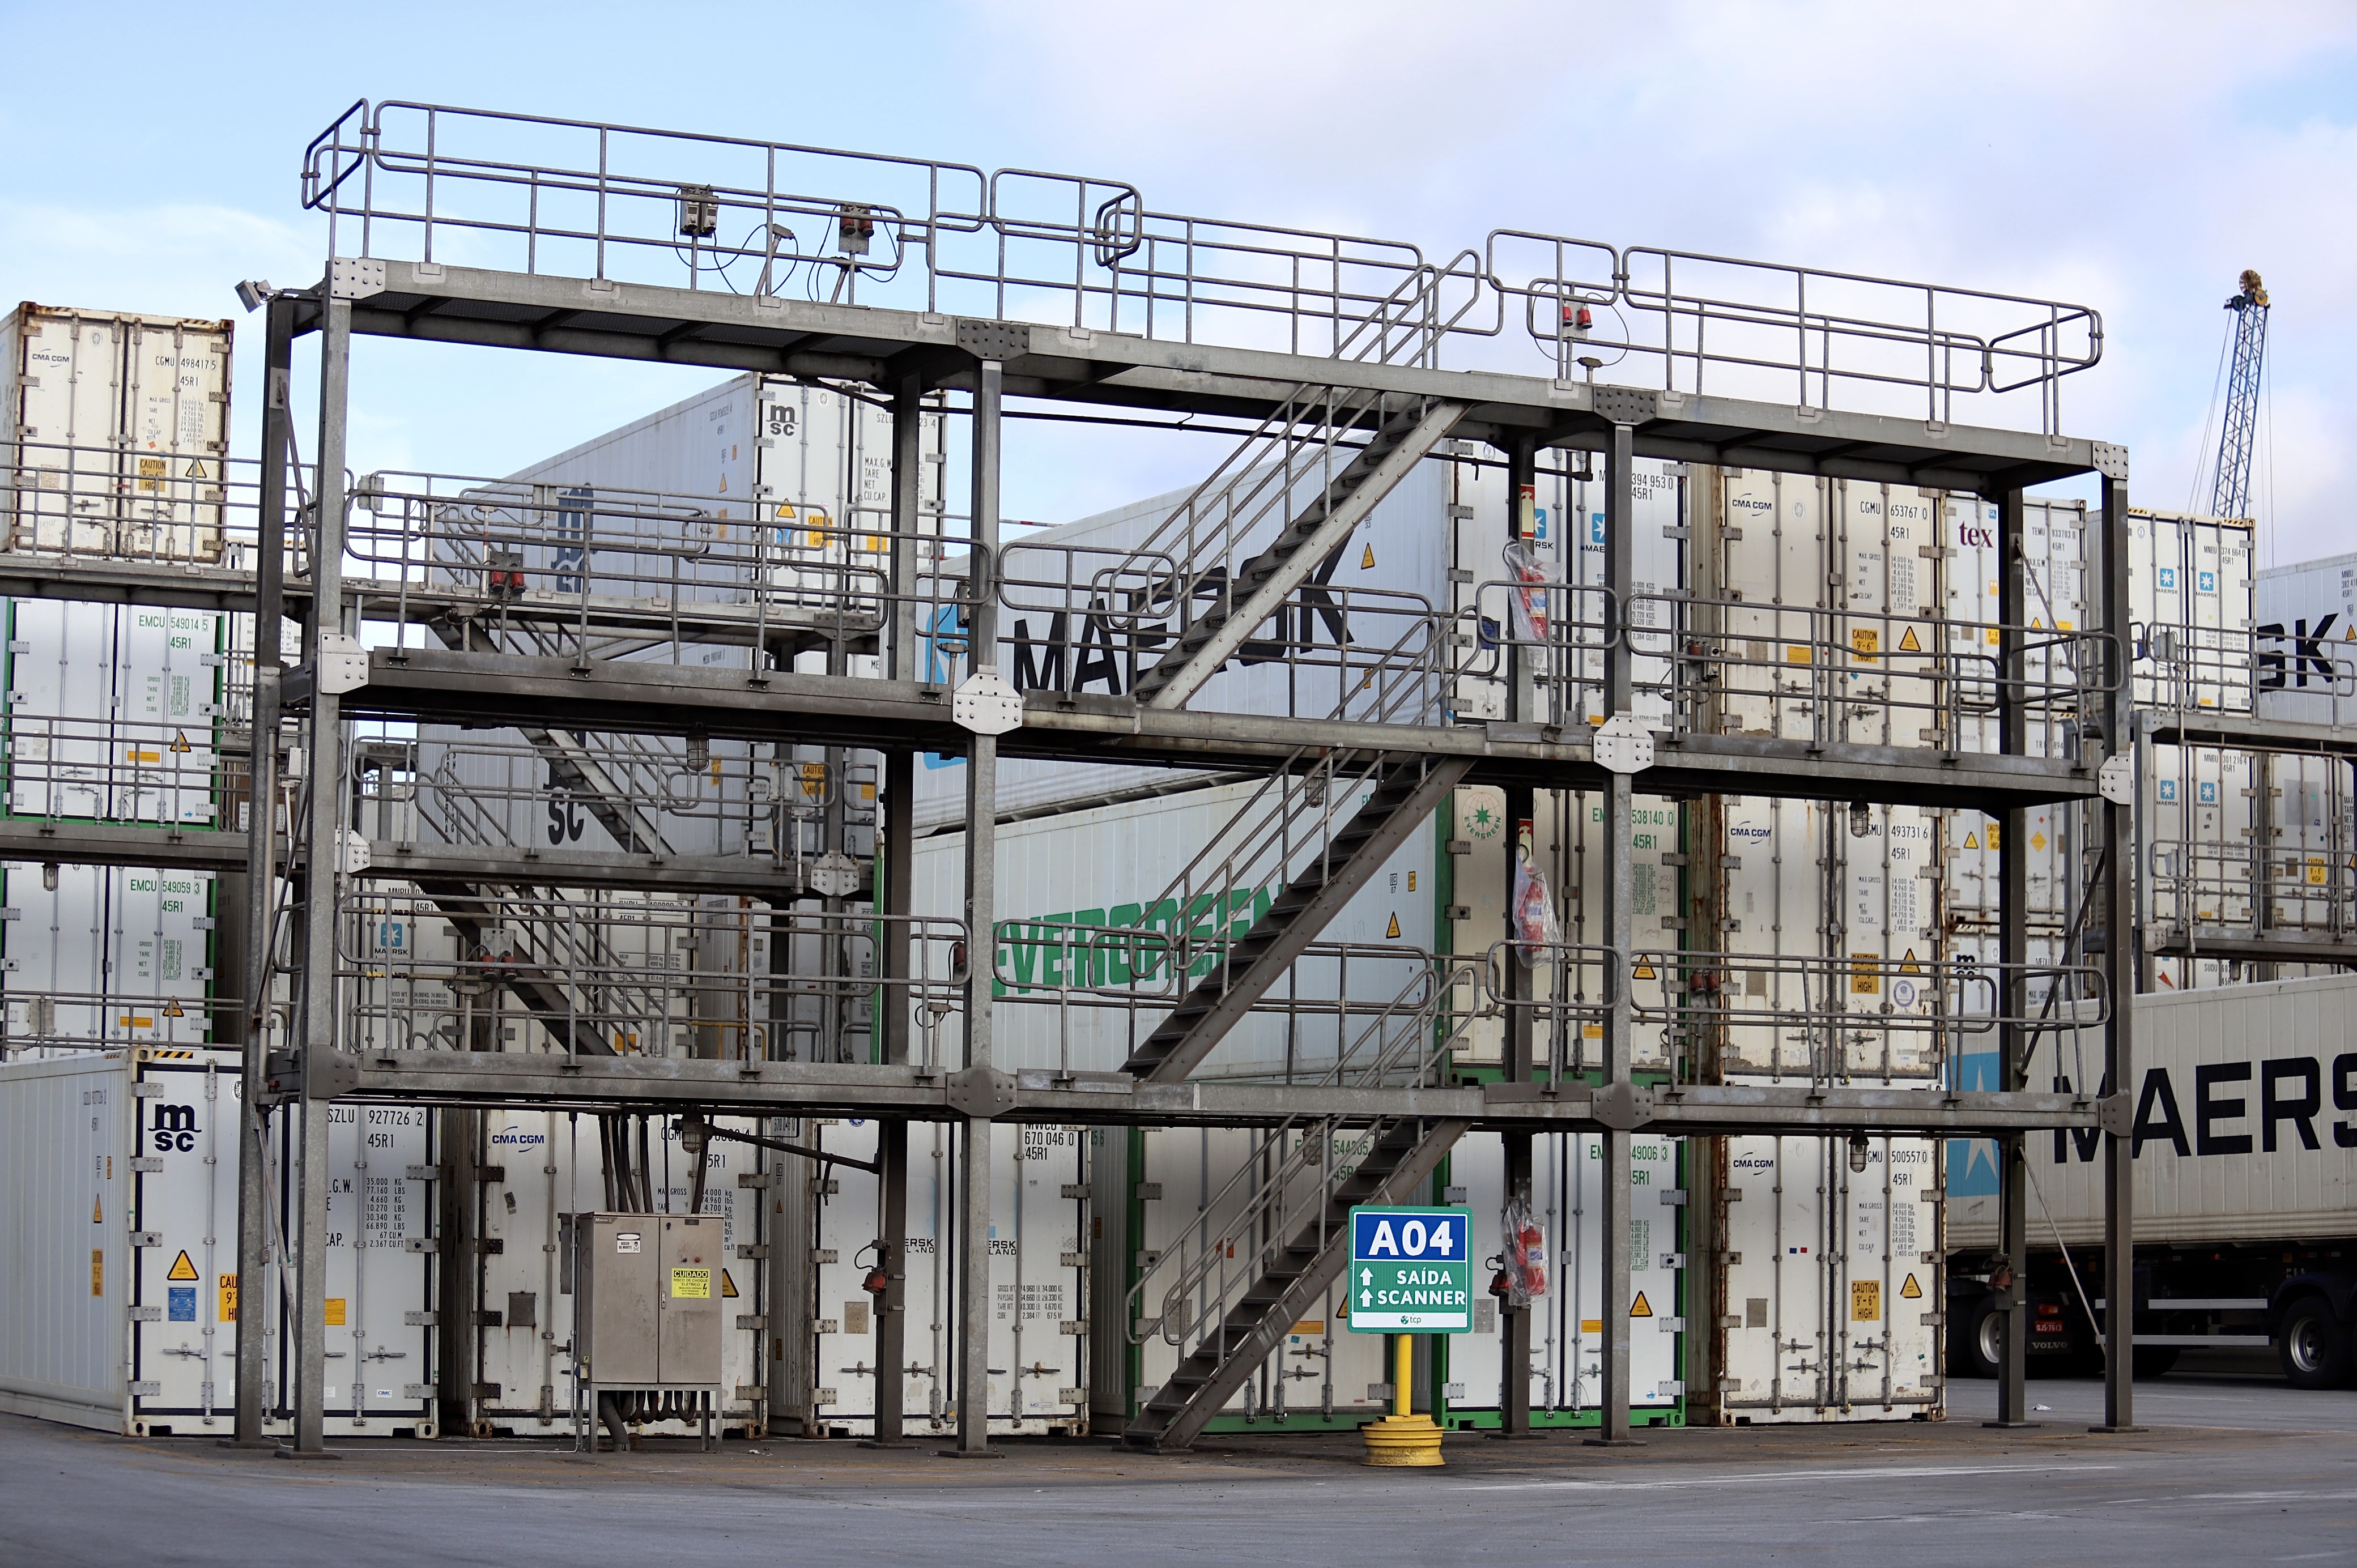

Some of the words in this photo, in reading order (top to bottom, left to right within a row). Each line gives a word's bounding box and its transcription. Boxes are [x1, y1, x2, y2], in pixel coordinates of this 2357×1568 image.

[32, 353, 50, 361] CMA
[155, 356, 175, 367] CGMU
[181, 357, 209, 370] 498417
[180, 376, 199, 387] 45R1
[140, 459, 165, 470] CAUTION
[865, 468, 879, 479] TARE
[864, 480, 875, 489] NET
[1632, 473, 1648, 486] 394
[1649, 475, 1666, 488] 953
[863, 491, 887, 502] CU.CAP.
[1632, 487, 1653, 501] 45R1
[1732, 499, 1751, 509] CMA
[1752, 501, 1772, 510] CGM
[1860, 501, 1881, 514] CGMU
[1890, 504, 1918, 519] 653767
[1890, 526, 1910, 540] 45R1
[1959, 520, 1993, 548] tex
[2031, 527, 2045, 536] TEMU
[2052, 542, 2065, 551] 45R1
[2203, 546, 2217, 555] MNBU
[2221, 547, 2231, 556] 374
[2232, 549, 2241, 557] 664
[2342, 570, 2354, 578] MNBU
[2342, 589, 2352, 598] 45R1
[139, 615, 165, 628] EMCU
[171, 616, 199, 630] 549014
[203, 620, 208, 631] 5
[1853, 629, 1877, 641] CAUTION
[170, 637, 192, 649] 45R1
[2203, 754, 2219, 763] MNBU
[2233, 756, 2243, 765] 216
[2223, 765, 2235, 773] 45R1
[1632, 809, 1663, 825] 538140
[1463, 816, 1501, 840] EVERGREEN
[1731, 828, 1750, 837] CMA
[1751, 829, 1771, 838] CGM
[1633, 833, 1657, 850] 45R1
[1891, 847, 1911, 860] 45R1
[130, 879, 157, 892] EMCU
[162, 880, 191, 894] 549059
[195, 883, 199, 894] 3
[162, 901, 183, 913] 45R1
[1857, 981, 1873, 993] HIGH
[329, 1109, 355, 1123] SZLU
[368, 1110, 410, 1126] 927726
[416, 1111, 424, 1127] 2
[367, 1133, 394, 1148] 45R1
[492, 1135, 518, 1144] CMA
[519, 1134, 544, 1144] CGM
[1024, 1132, 1043, 1145] 670
[1046, 1133, 1064, 1146] 046
[1067, 1133, 1075, 1147] 0
[1026, 1147, 1048, 1160] 45R1
[1867, 1151, 1883, 1163] GMU
[1891, 1151, 1921, 1163] 500557
[1922, 1151, 1928, 1163] 0
[708, 1154, 726, 1168] 5R1
[1630, 1170, 1650, 1185] 5R1
[1892, 1173, 1912, 1186] 45R1
[1368, 1220, 1453, 1256] A04
[1397, 1267, 1453, 1285] SAÍDA
[1852, 1282, 1879, 1293] CAUTION
[1377, 1290, 1466, 1305] SCANNER
[1857, 1308, 1873, 1319] HIGH
[1410, 1316, 1422, 1324] tcp
